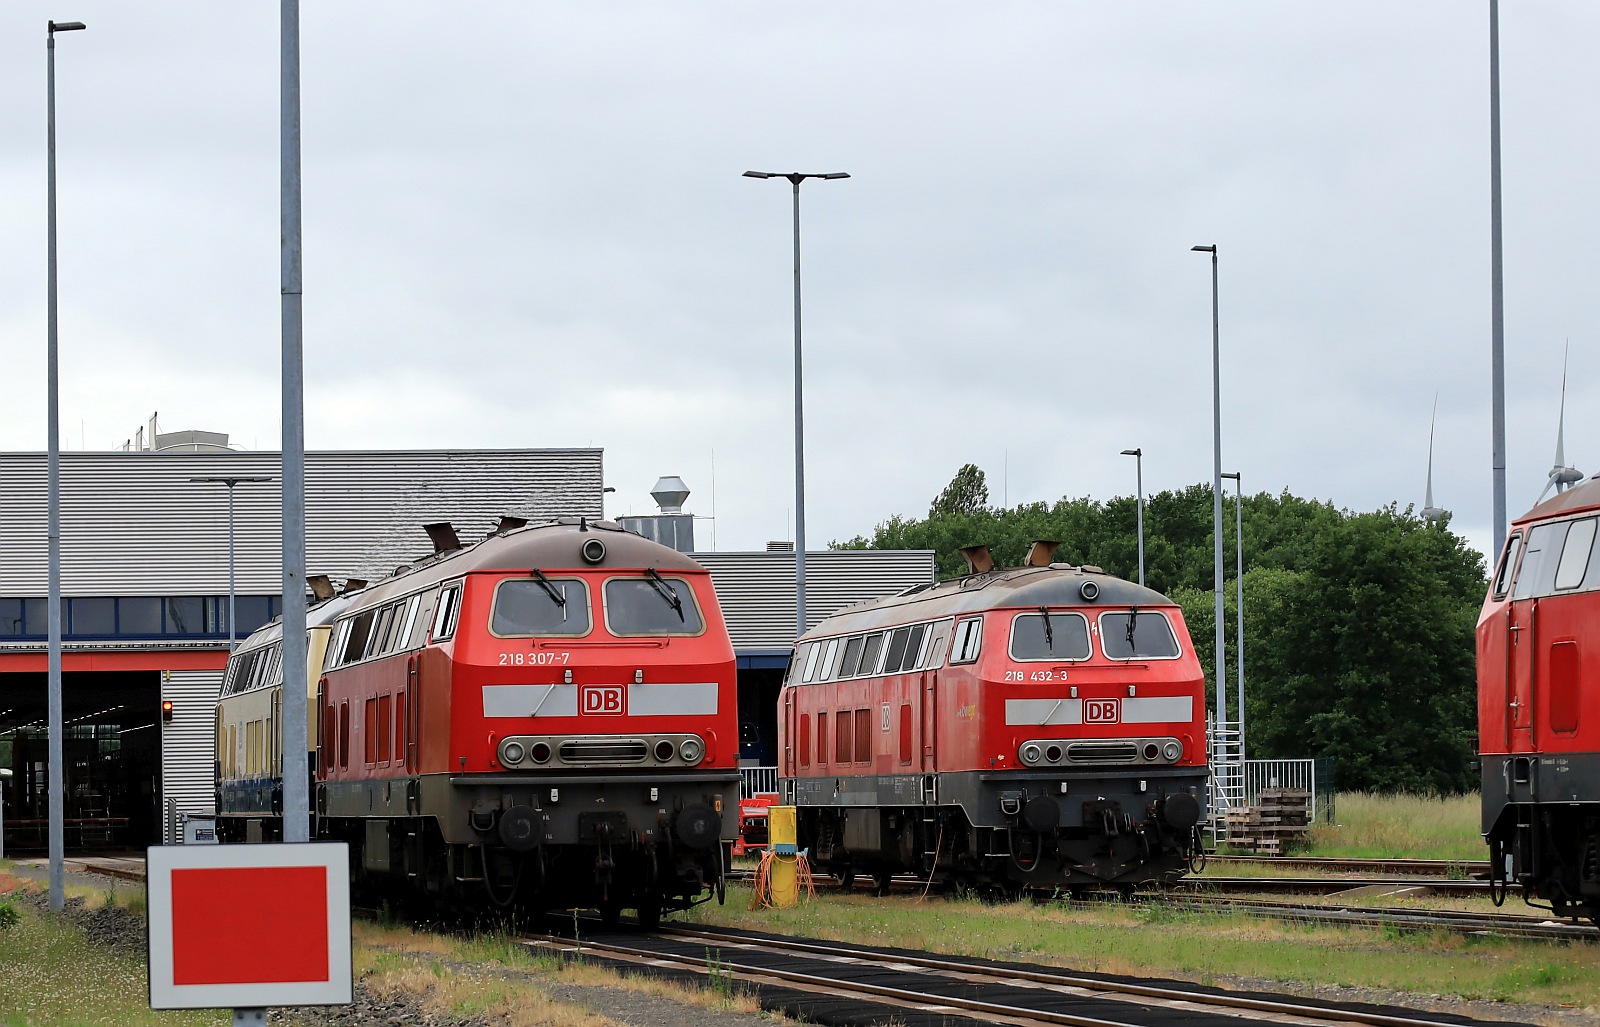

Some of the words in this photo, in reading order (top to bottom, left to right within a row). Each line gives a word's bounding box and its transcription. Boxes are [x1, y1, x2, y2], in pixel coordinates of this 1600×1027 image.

[499, 653, 524, 665] 218
[528, 652, 570, 665] 307-7
[1004, 671, 1024, 681] 218
[1030, 671, 1068, 681] 432-3
[586, 690, 620, 711] DB
[1089, 703, 1115, 720] DB
